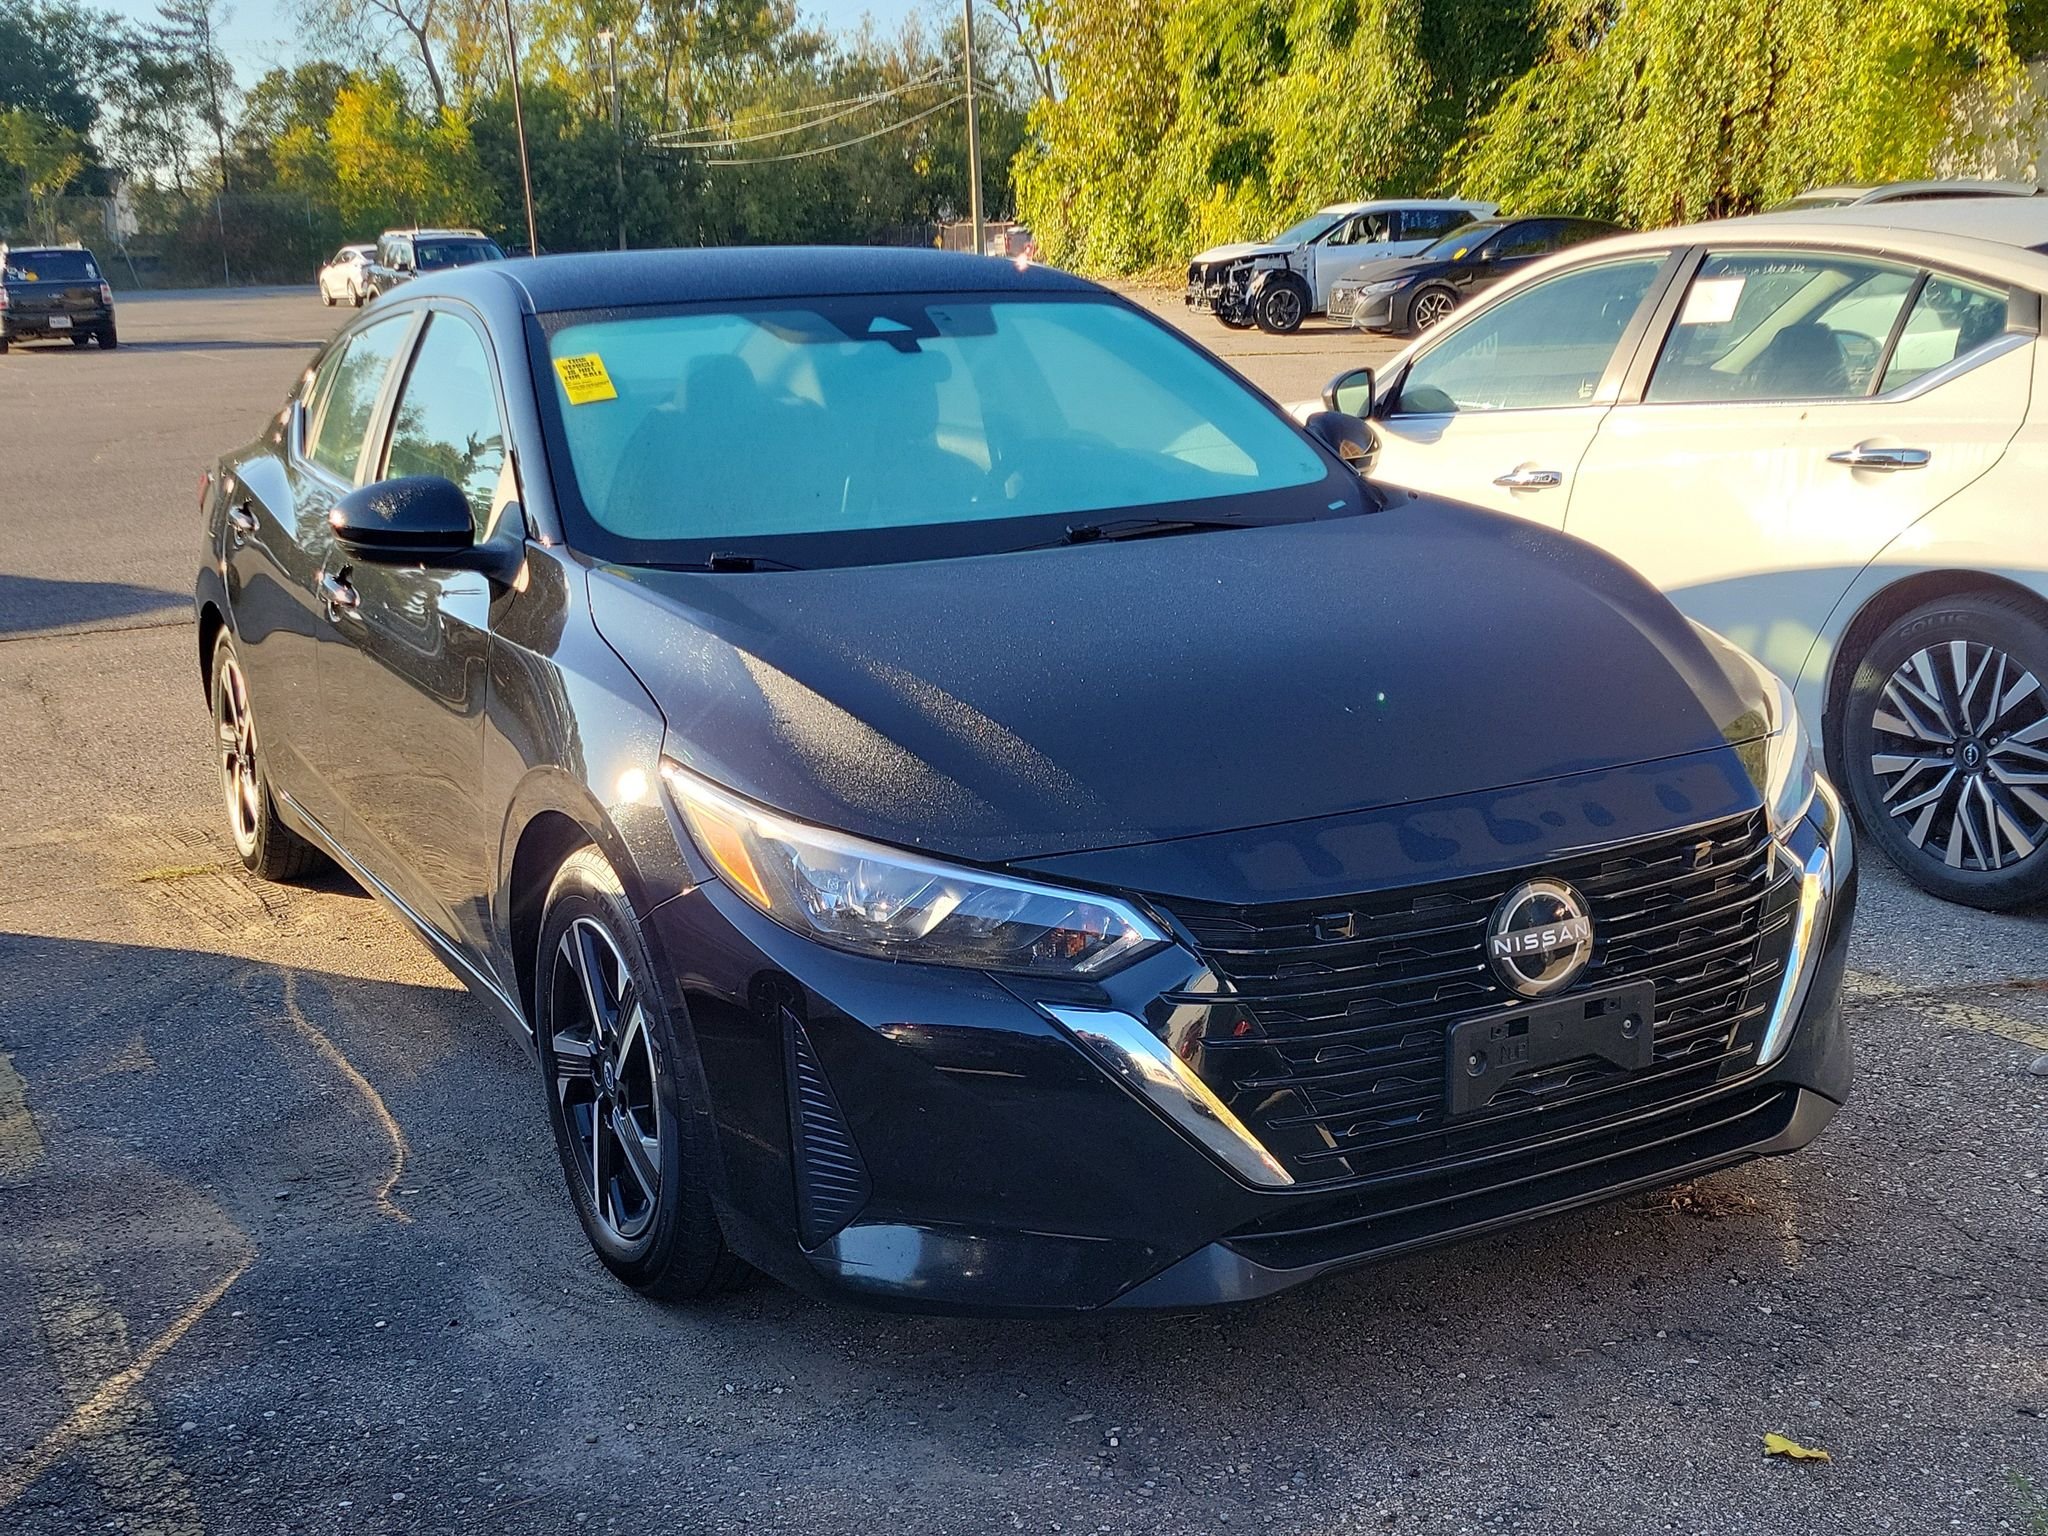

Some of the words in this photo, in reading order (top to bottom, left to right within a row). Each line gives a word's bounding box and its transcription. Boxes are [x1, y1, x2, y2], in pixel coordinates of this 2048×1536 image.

[564, 374, 581, 382] FOR
[582, 370, 602, 378] SALE
[578, 366, 595, 374] NOT
[1493, 920, 1588, 956] NISSAN
